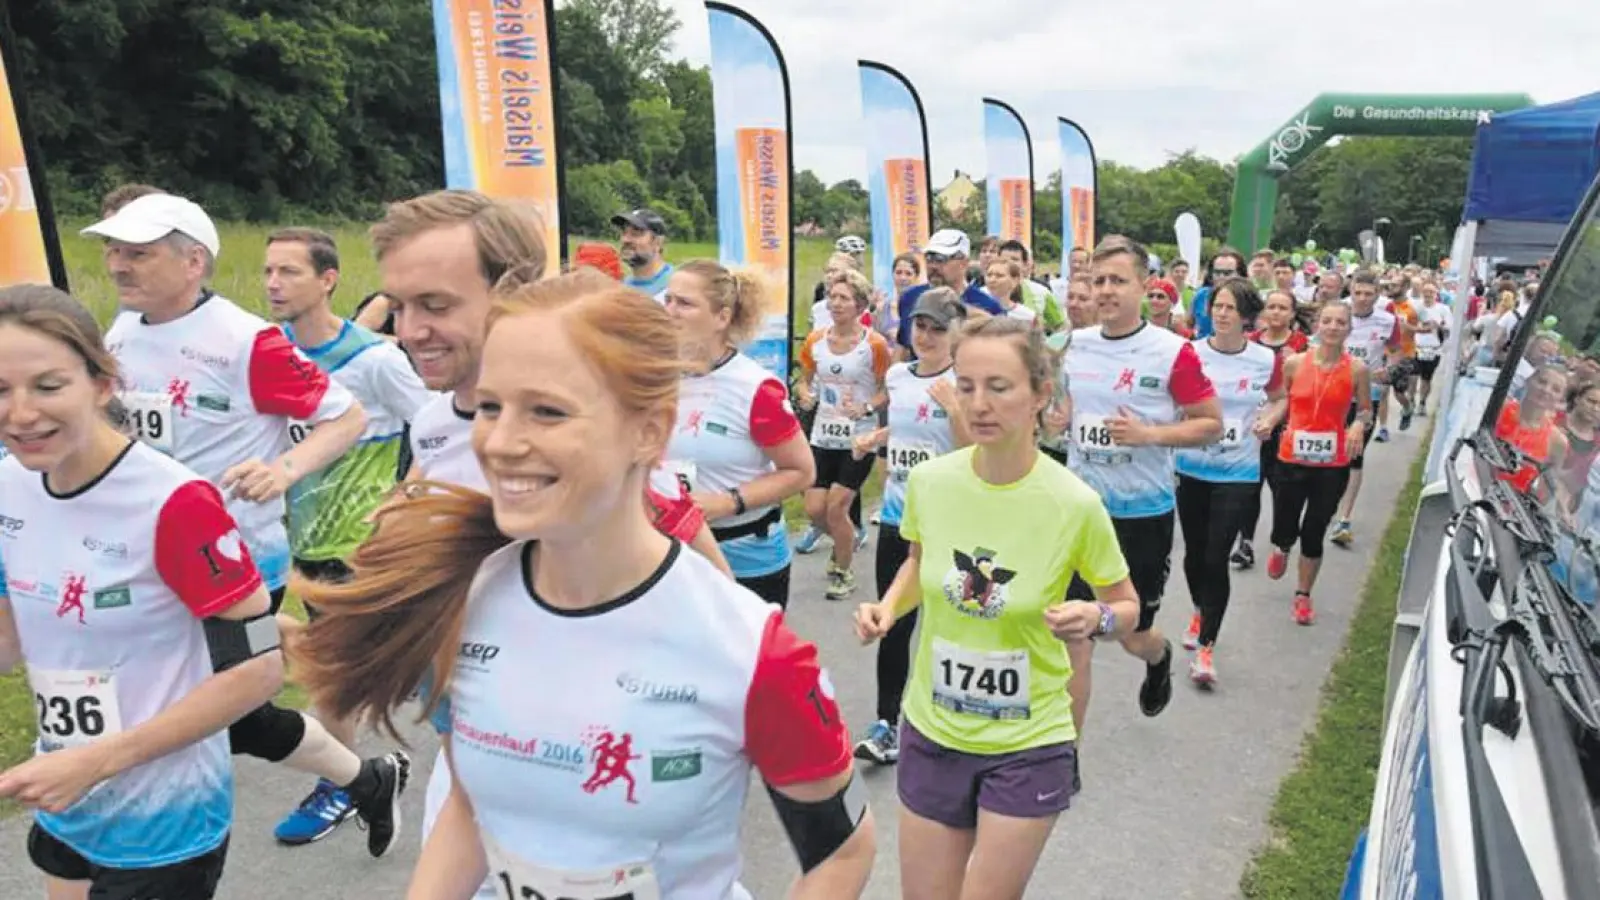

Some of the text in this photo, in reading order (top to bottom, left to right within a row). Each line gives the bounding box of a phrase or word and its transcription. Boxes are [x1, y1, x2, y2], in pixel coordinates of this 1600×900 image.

[1332, 104, 1356, 119] Die
[1267, 110, 1325, 168] AOK
[821, 423, 851, 437] 1424
[1299, 439, 1332, 452] 1754
[940, 657, 1020, 697] 1740
[541, 740, 583, 765] 2016
